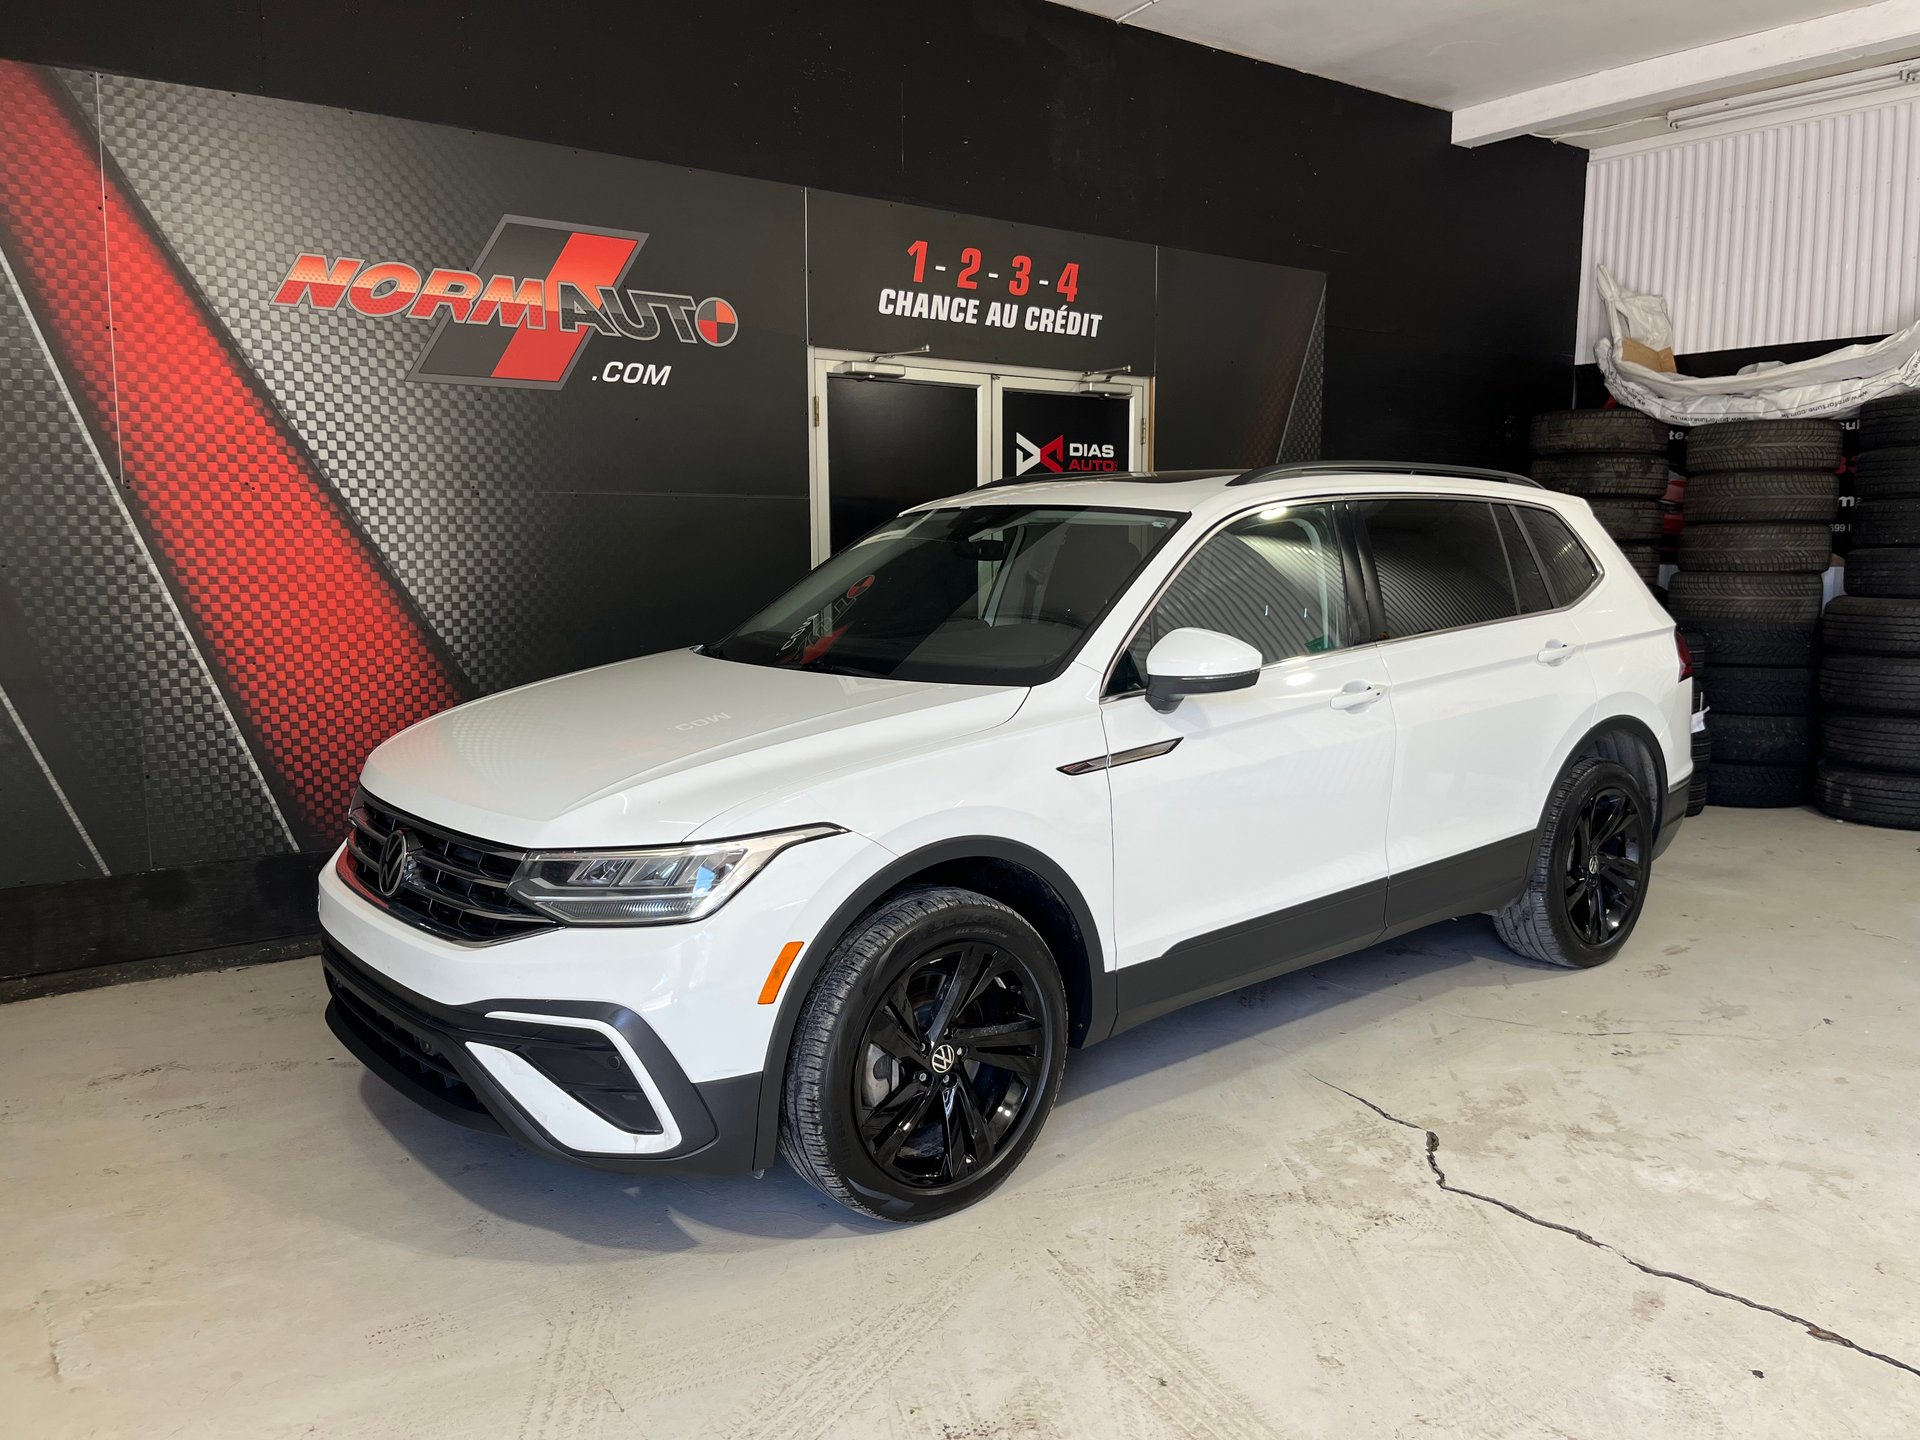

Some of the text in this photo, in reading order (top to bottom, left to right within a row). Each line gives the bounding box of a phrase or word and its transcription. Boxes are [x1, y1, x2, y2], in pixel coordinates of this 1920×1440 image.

[878, 288, 1103, 338] CHANCE AU CRÉDIT
[591, 361, 672, 386] .COM
[1069, 443, 1114, 458] DIAS
[1068, 459, 1116, 472] AUTO
